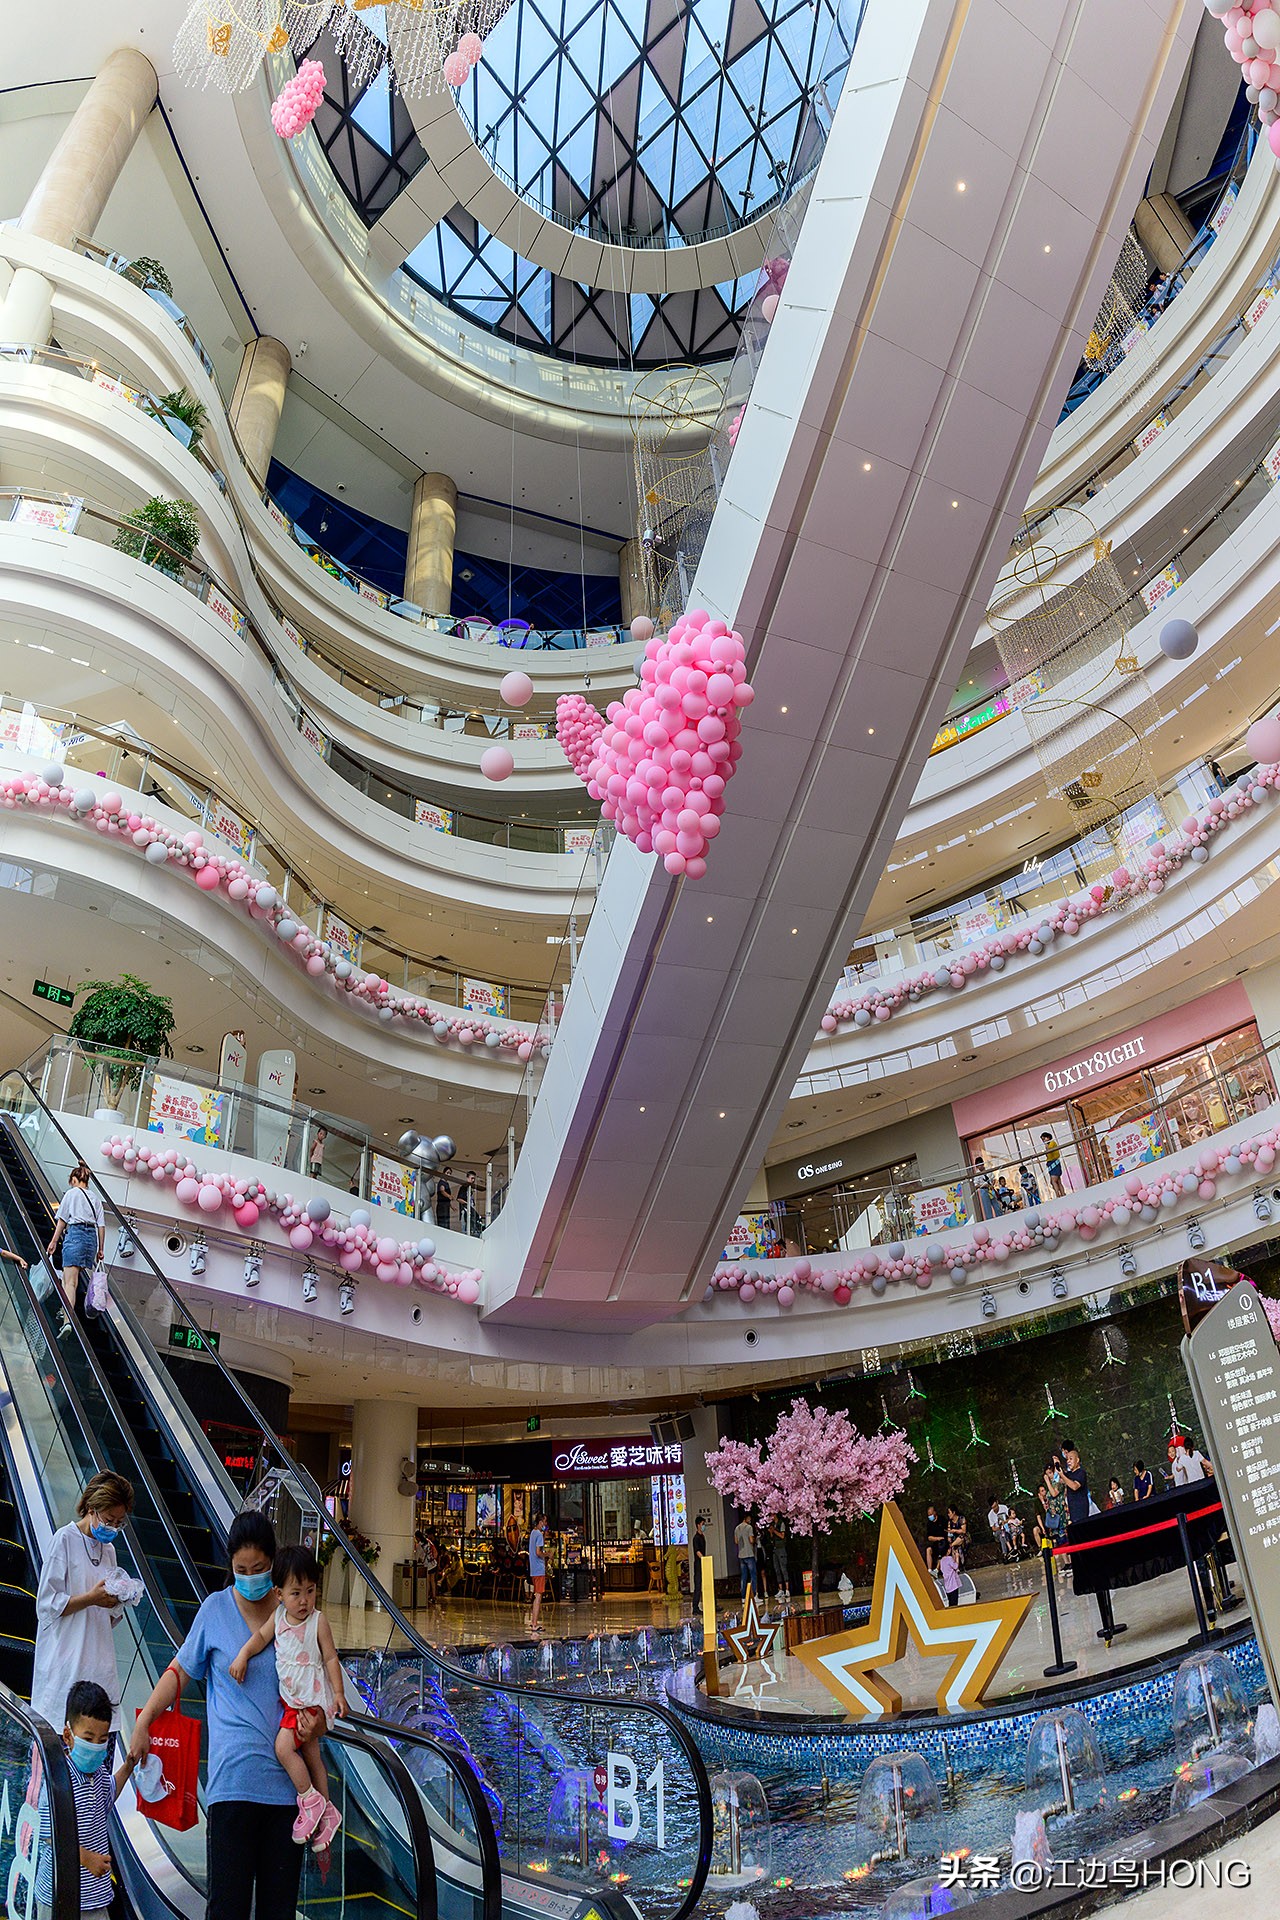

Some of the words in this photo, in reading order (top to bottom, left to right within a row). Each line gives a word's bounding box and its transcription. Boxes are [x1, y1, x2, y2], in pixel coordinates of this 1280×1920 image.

[1044, 1036, 1146, 1092] 6IXTY8IGHT
[1190, 1267, 1216, 1298] B1
[1227, 1312, 1258, 1330] 楼层索引
[610, 1444, 682, 1468] 愛芝味特
[608, 1752, 664, 1848] B1
